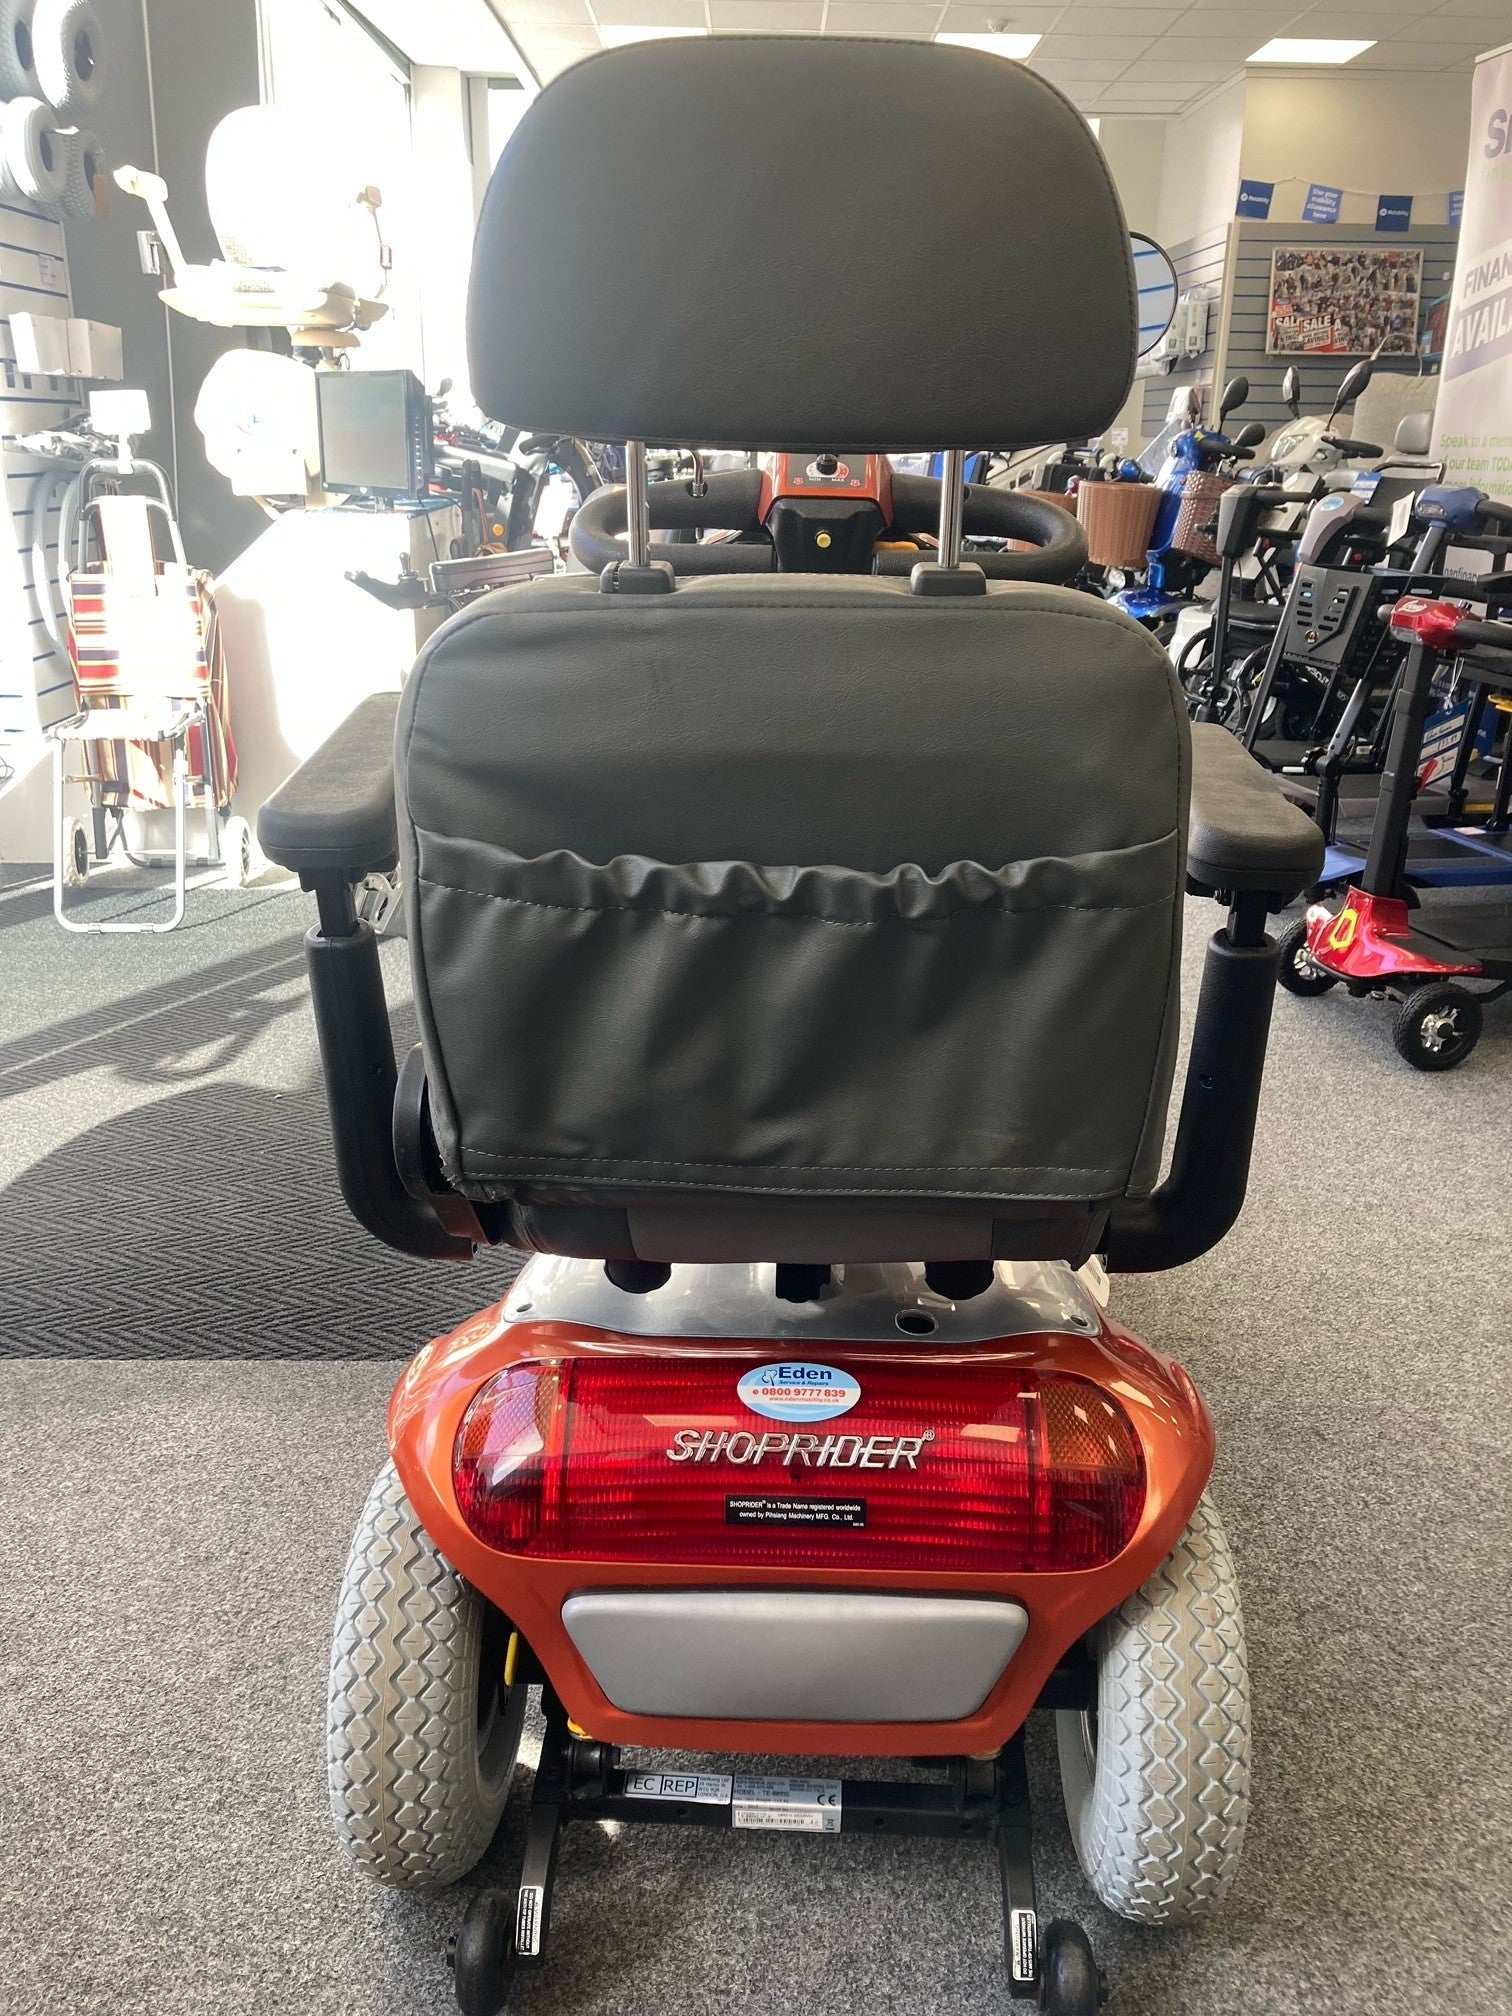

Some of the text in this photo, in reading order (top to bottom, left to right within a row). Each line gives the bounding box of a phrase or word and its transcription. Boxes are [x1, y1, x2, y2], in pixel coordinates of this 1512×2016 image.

[1303, 315, 1332, 332] SALE
[778, 1366, 832, 1380] Eden
[762, 1387, 846, 1398] 0800 9777 839
[777, 1502, 792, 1510] Trade
[788, 1512, 815, 1521] Machinery
[633, 1777, 656, 1791] EC
[663, 1779, 695, 1794] REP
